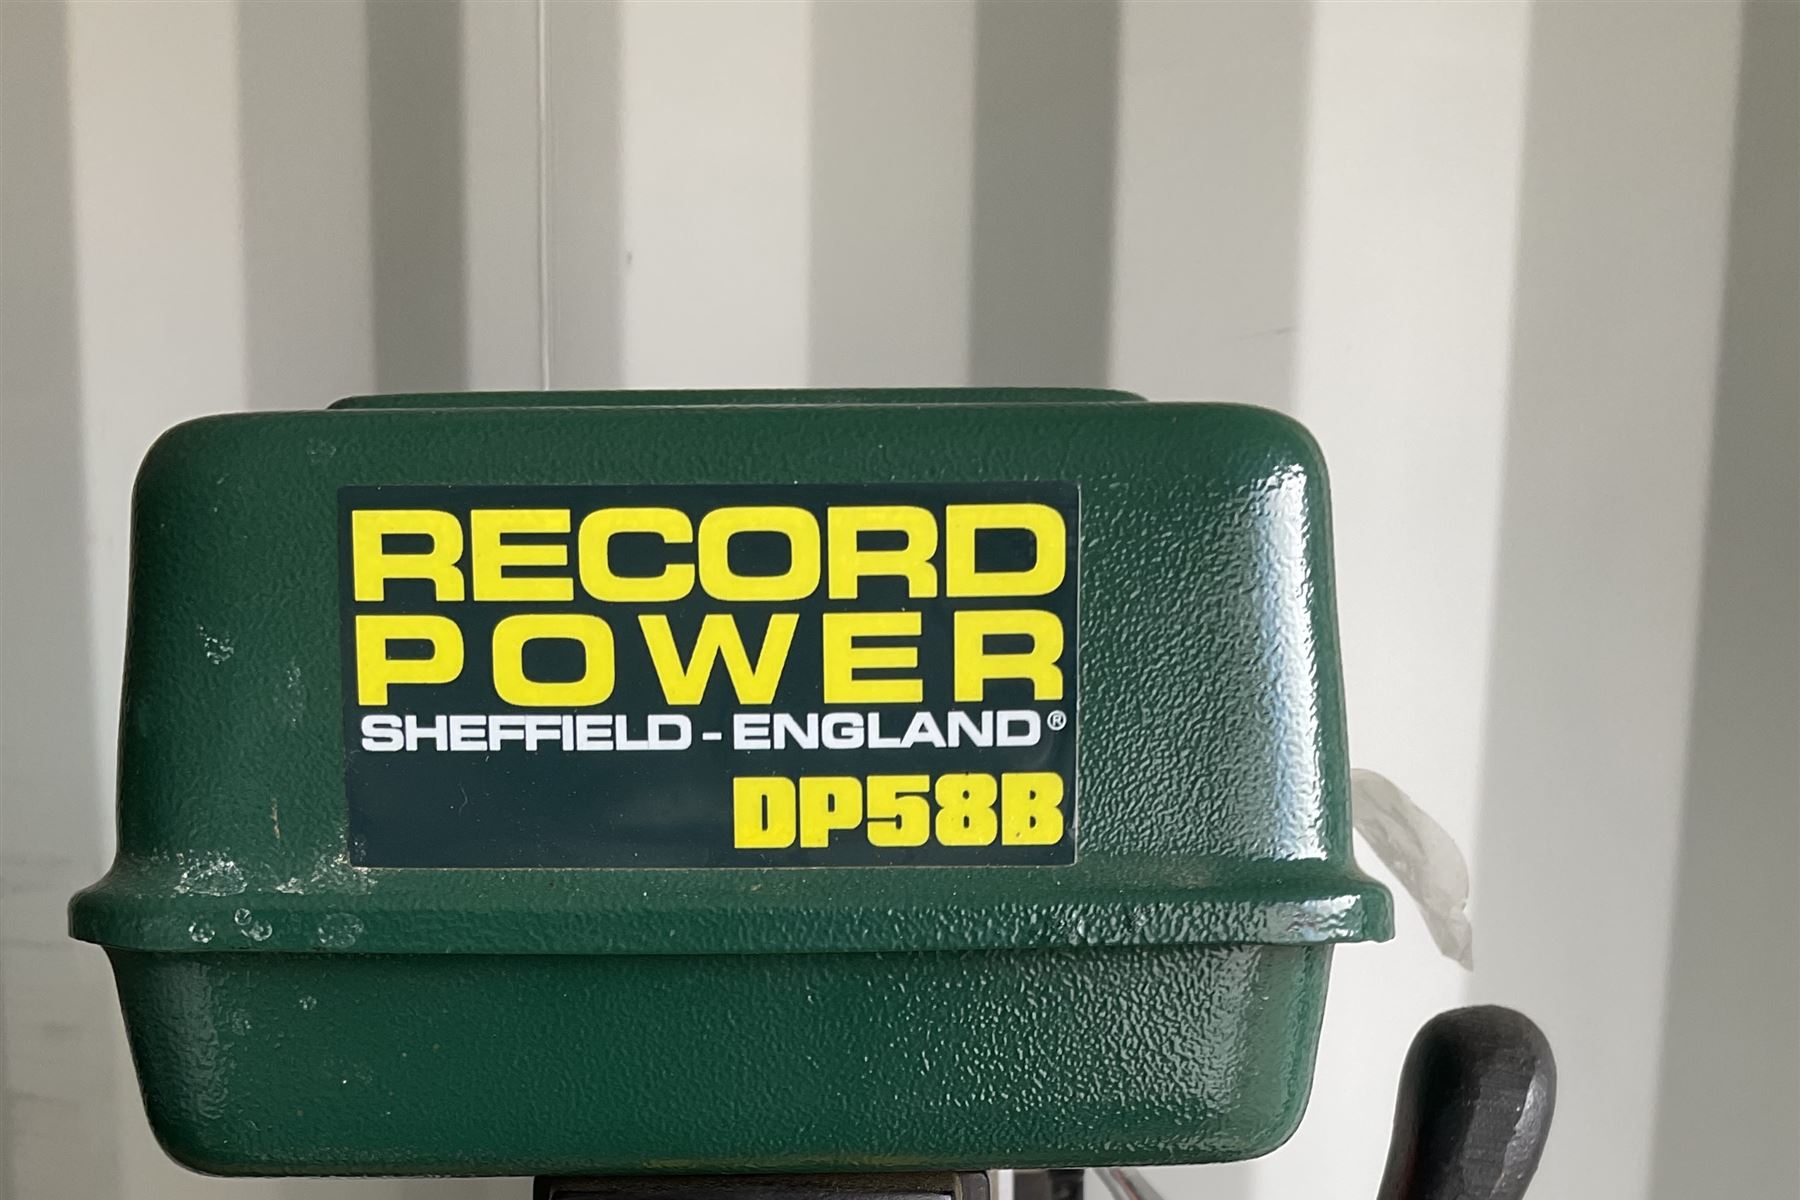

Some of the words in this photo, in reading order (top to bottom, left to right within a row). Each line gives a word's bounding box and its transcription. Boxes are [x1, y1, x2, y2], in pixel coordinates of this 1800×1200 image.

[351, 503, 1067, 602] RECORD
[354, 609, 1065, 707] POWER
[360, 713, 693, 752] SHEFFIELD
[732, 771, 1065, 849] DP58B
